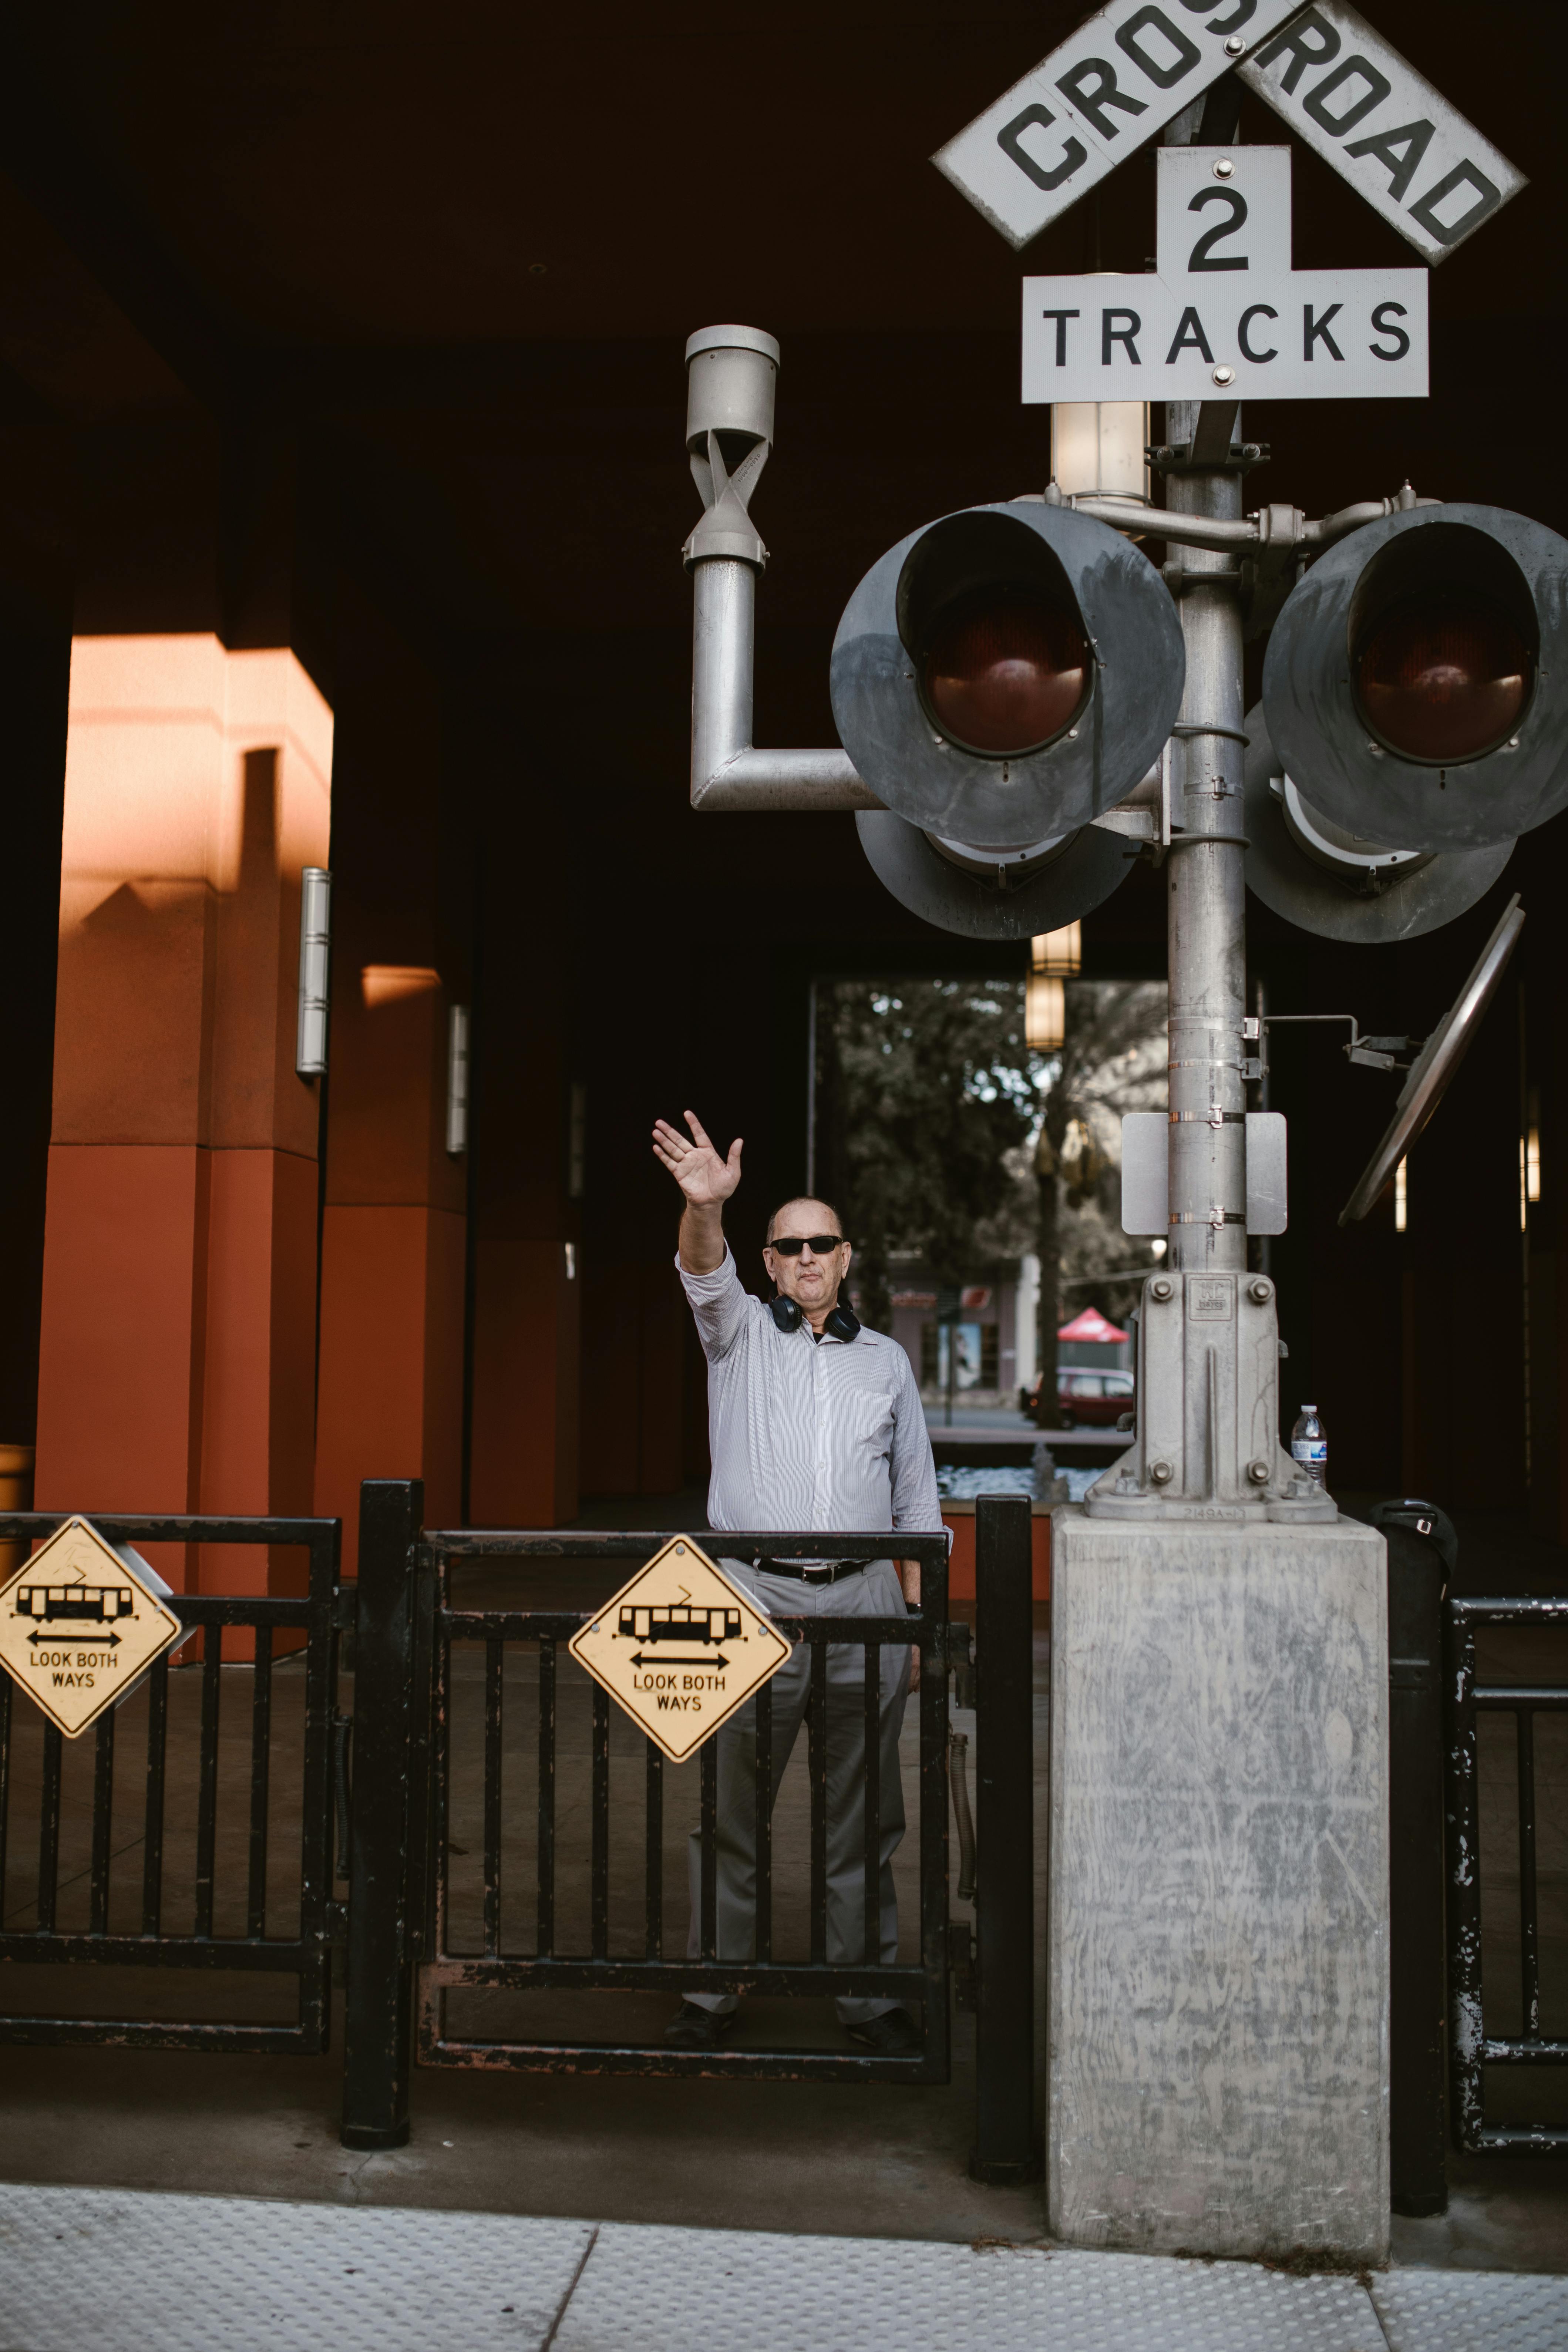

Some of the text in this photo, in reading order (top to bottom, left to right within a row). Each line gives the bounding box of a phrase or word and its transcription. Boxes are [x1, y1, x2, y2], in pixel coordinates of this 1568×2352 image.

[1253, 6, 1502, 246] ROAD
[1188, 186, 1249, 272] 2
[1043, 302, 1410, 366] TRACKS
[30, 1652, 117, 1668] LOOK BOTH
[52, 1673, 95, 1688] WAYS
[634, 1675, 725, 1690] LOOK BOTH
[657, 1696, 701, 1711] WAYS
